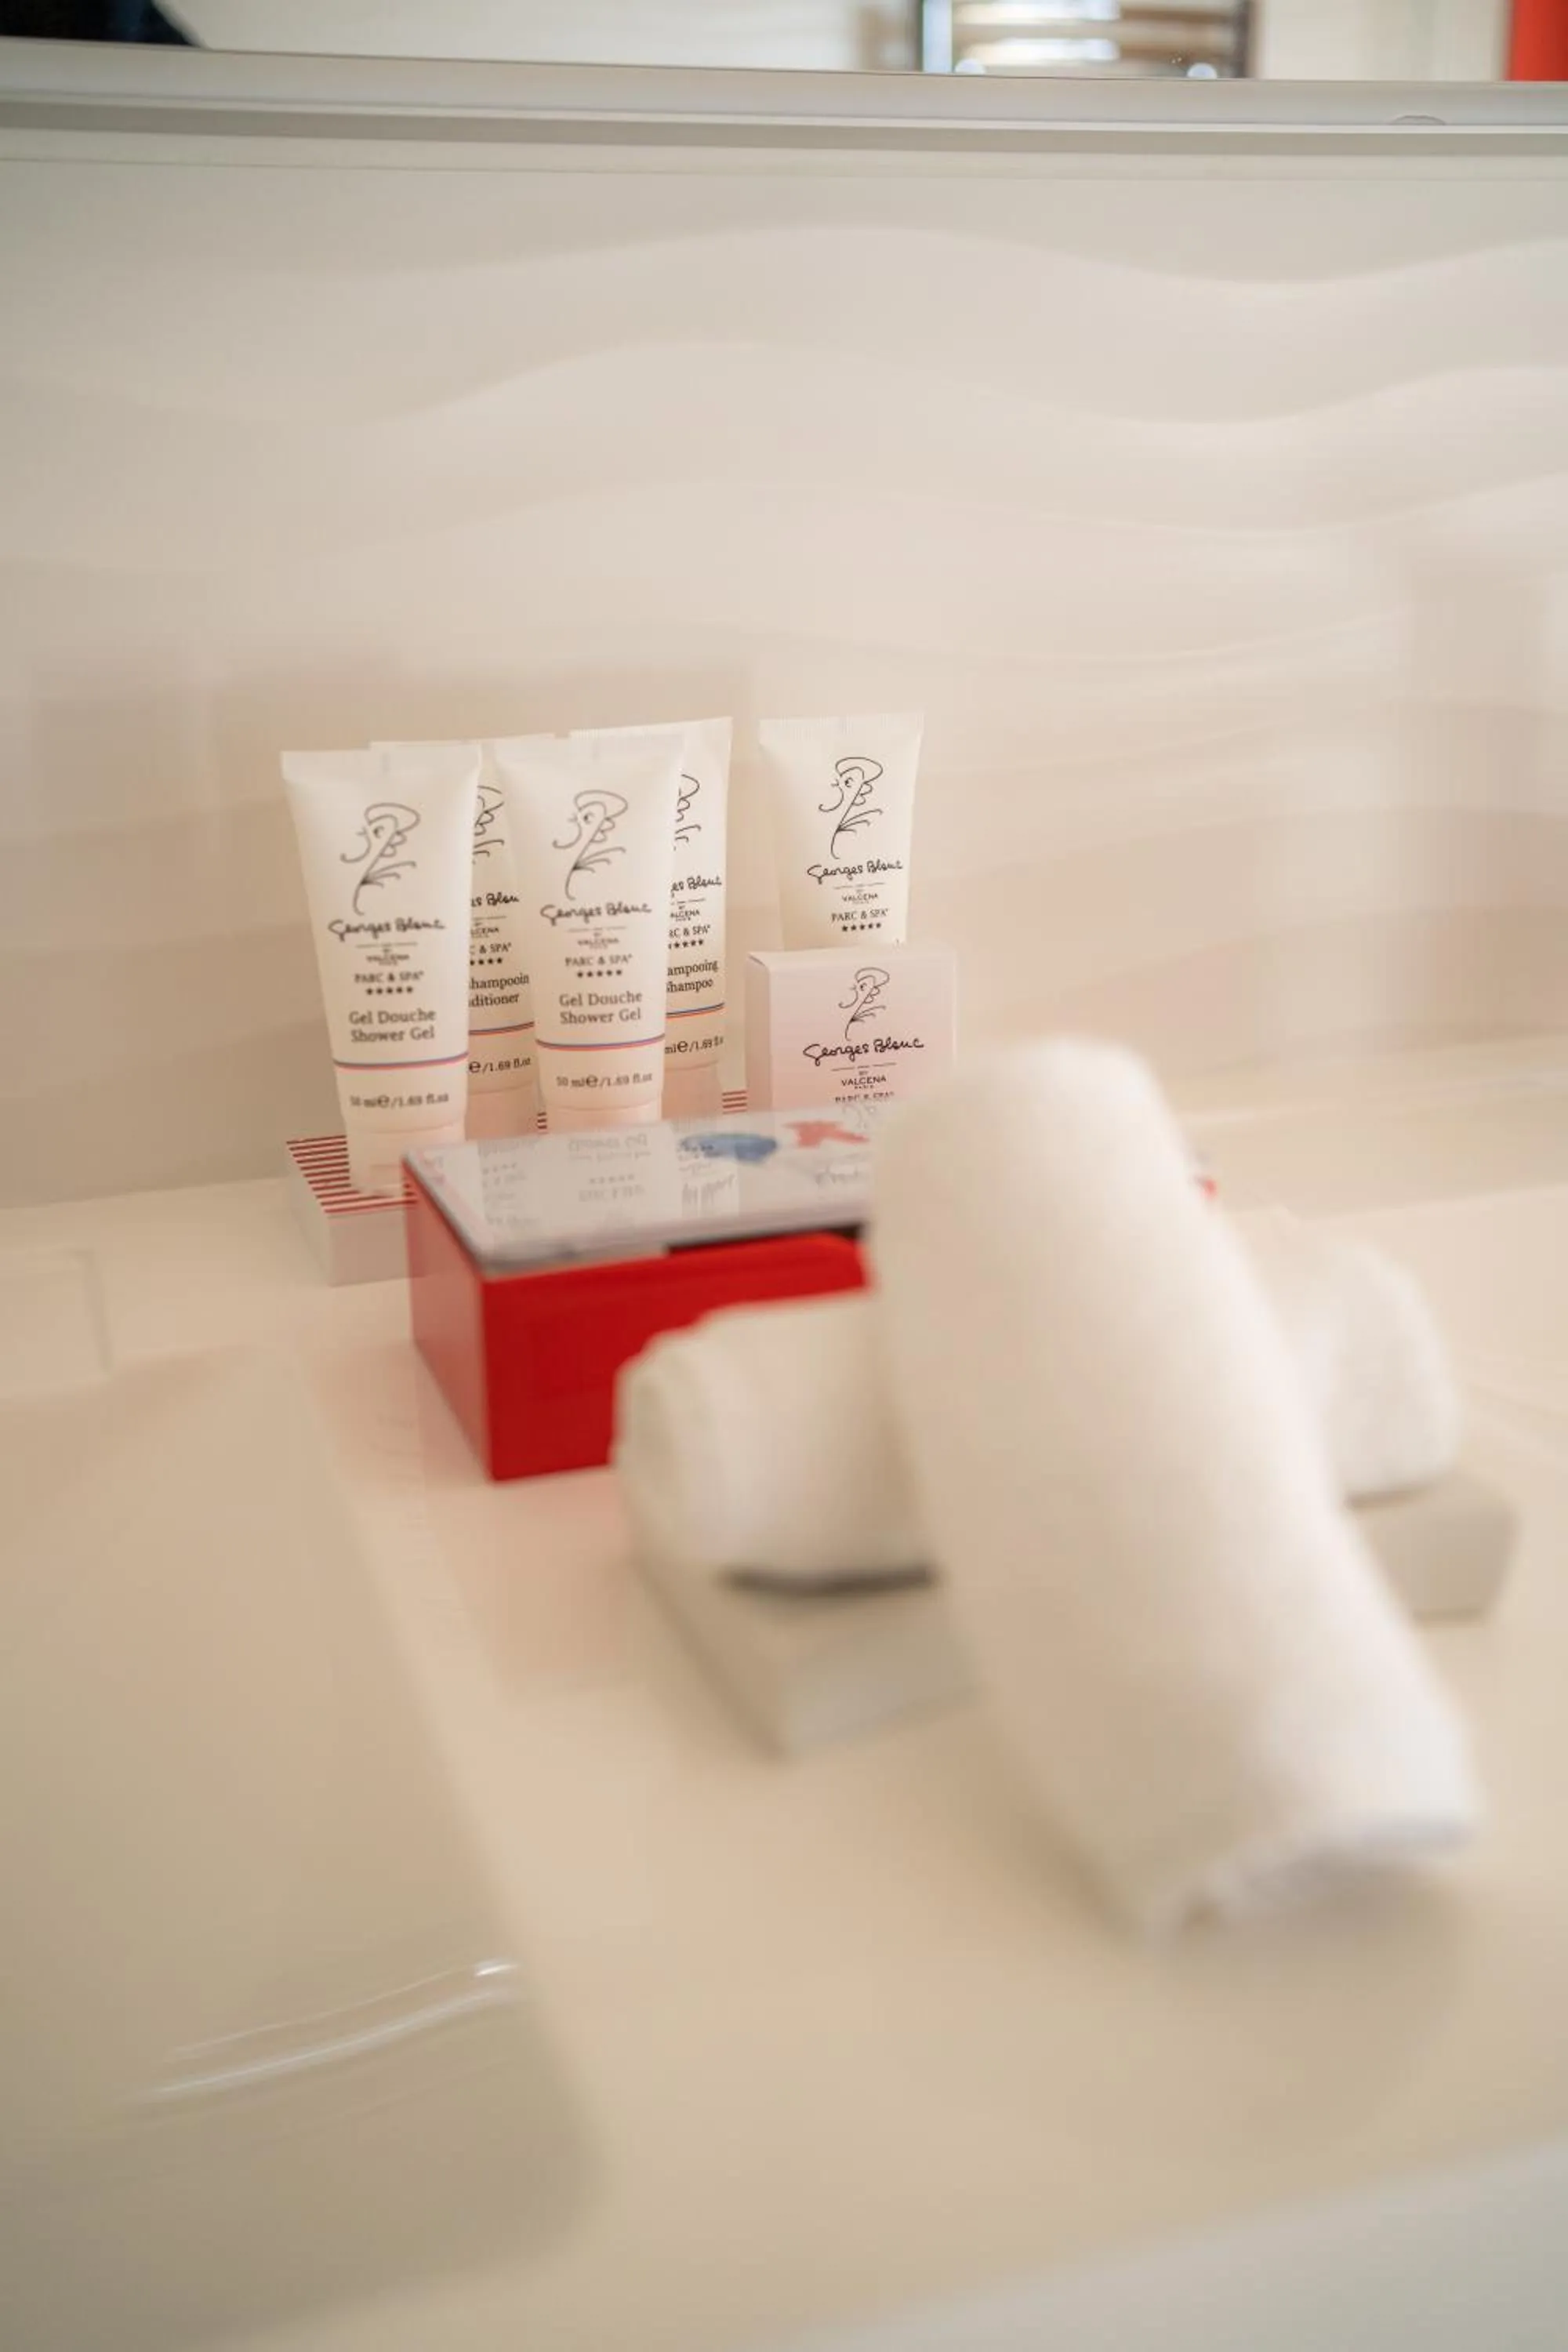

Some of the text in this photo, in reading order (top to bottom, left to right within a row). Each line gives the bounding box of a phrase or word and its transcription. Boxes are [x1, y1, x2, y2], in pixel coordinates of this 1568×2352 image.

[808, 859, 903, 884] Georges Blanc
[540, 901, 652, 926] Georges Blanc
[831, 911, 858, 922] PARC
[328, 919, 390, 942] Georges
[564, 956, 594, 966] PARC
[559, 990, 643, 1007] Gel Douche
[348, 1008, 437, 1025] Gel Douche
[560, 1007, 641, 1025] Shower Gel
[350, 1025, 435, 1044] Shower Gel
[803, 1036, 924, 1066] Georges Blanc
[841, 1075, 887, 1087] VALCENA
